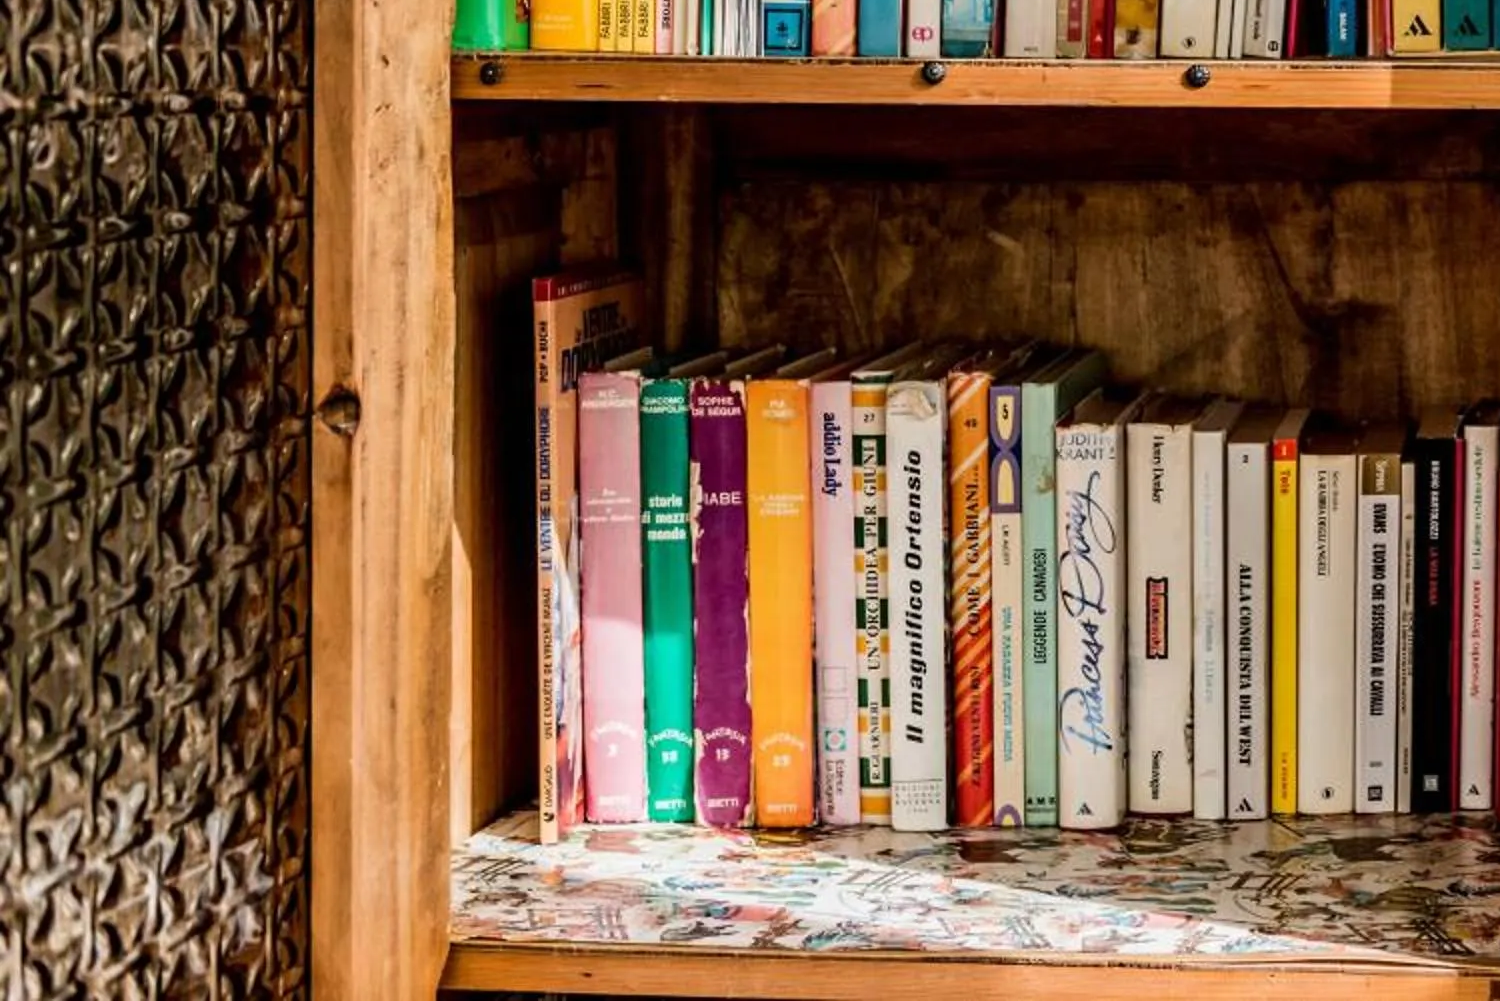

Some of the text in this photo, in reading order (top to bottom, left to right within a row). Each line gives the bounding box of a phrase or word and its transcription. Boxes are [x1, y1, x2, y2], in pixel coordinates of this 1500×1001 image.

[601, 2, 613, 39] FABBRI
[619, 0, 631, 38] FABBRI
[639, 0, 650, 38] FABBRI
[697, 397, 735, 406] SOPHIE
[863, 413, 875, 423] 27
[538, 406, 550, 480] DORYPHORE
[820, 411, 841, 497] addio Lady
[1150, 434, 1165, 466] Henry
[648, 495, 684, 508] storie
[904, 449, 923, 571] Ortensio
[1373, 502, 1388, 533] EVANS
[538, 507, 552, 552] VENTRE
[647, 529, 687, 541] mondo
[864, 504, 879, 538] PER
[541, 558, 553, 571] LE
[865, 547, 881, 671] UN'ORCHIDEA
[1033, 548, 1047, 665] LEGGENDE CANADESI
[1371, 582, 1386, 601] CHE
[966, 588, 981, 637] COME
[1058, 471, 1116, 755] Princess Daisy
[904, 579, 927, 716] magnifico
[1370, 603, 1385, 664] SUSSURRAVA
[542, 662, 552, 674] DE
[1238, 563, 1253, 767] ALLA CONQUISTA DEL WEST
[1370, 666, 1384, 677] AI
[1369, 678, 1384, 716] CAVALLI
[542, 720, 553, 740] UNE
[543, 764, 553, 808] DARGAUD
